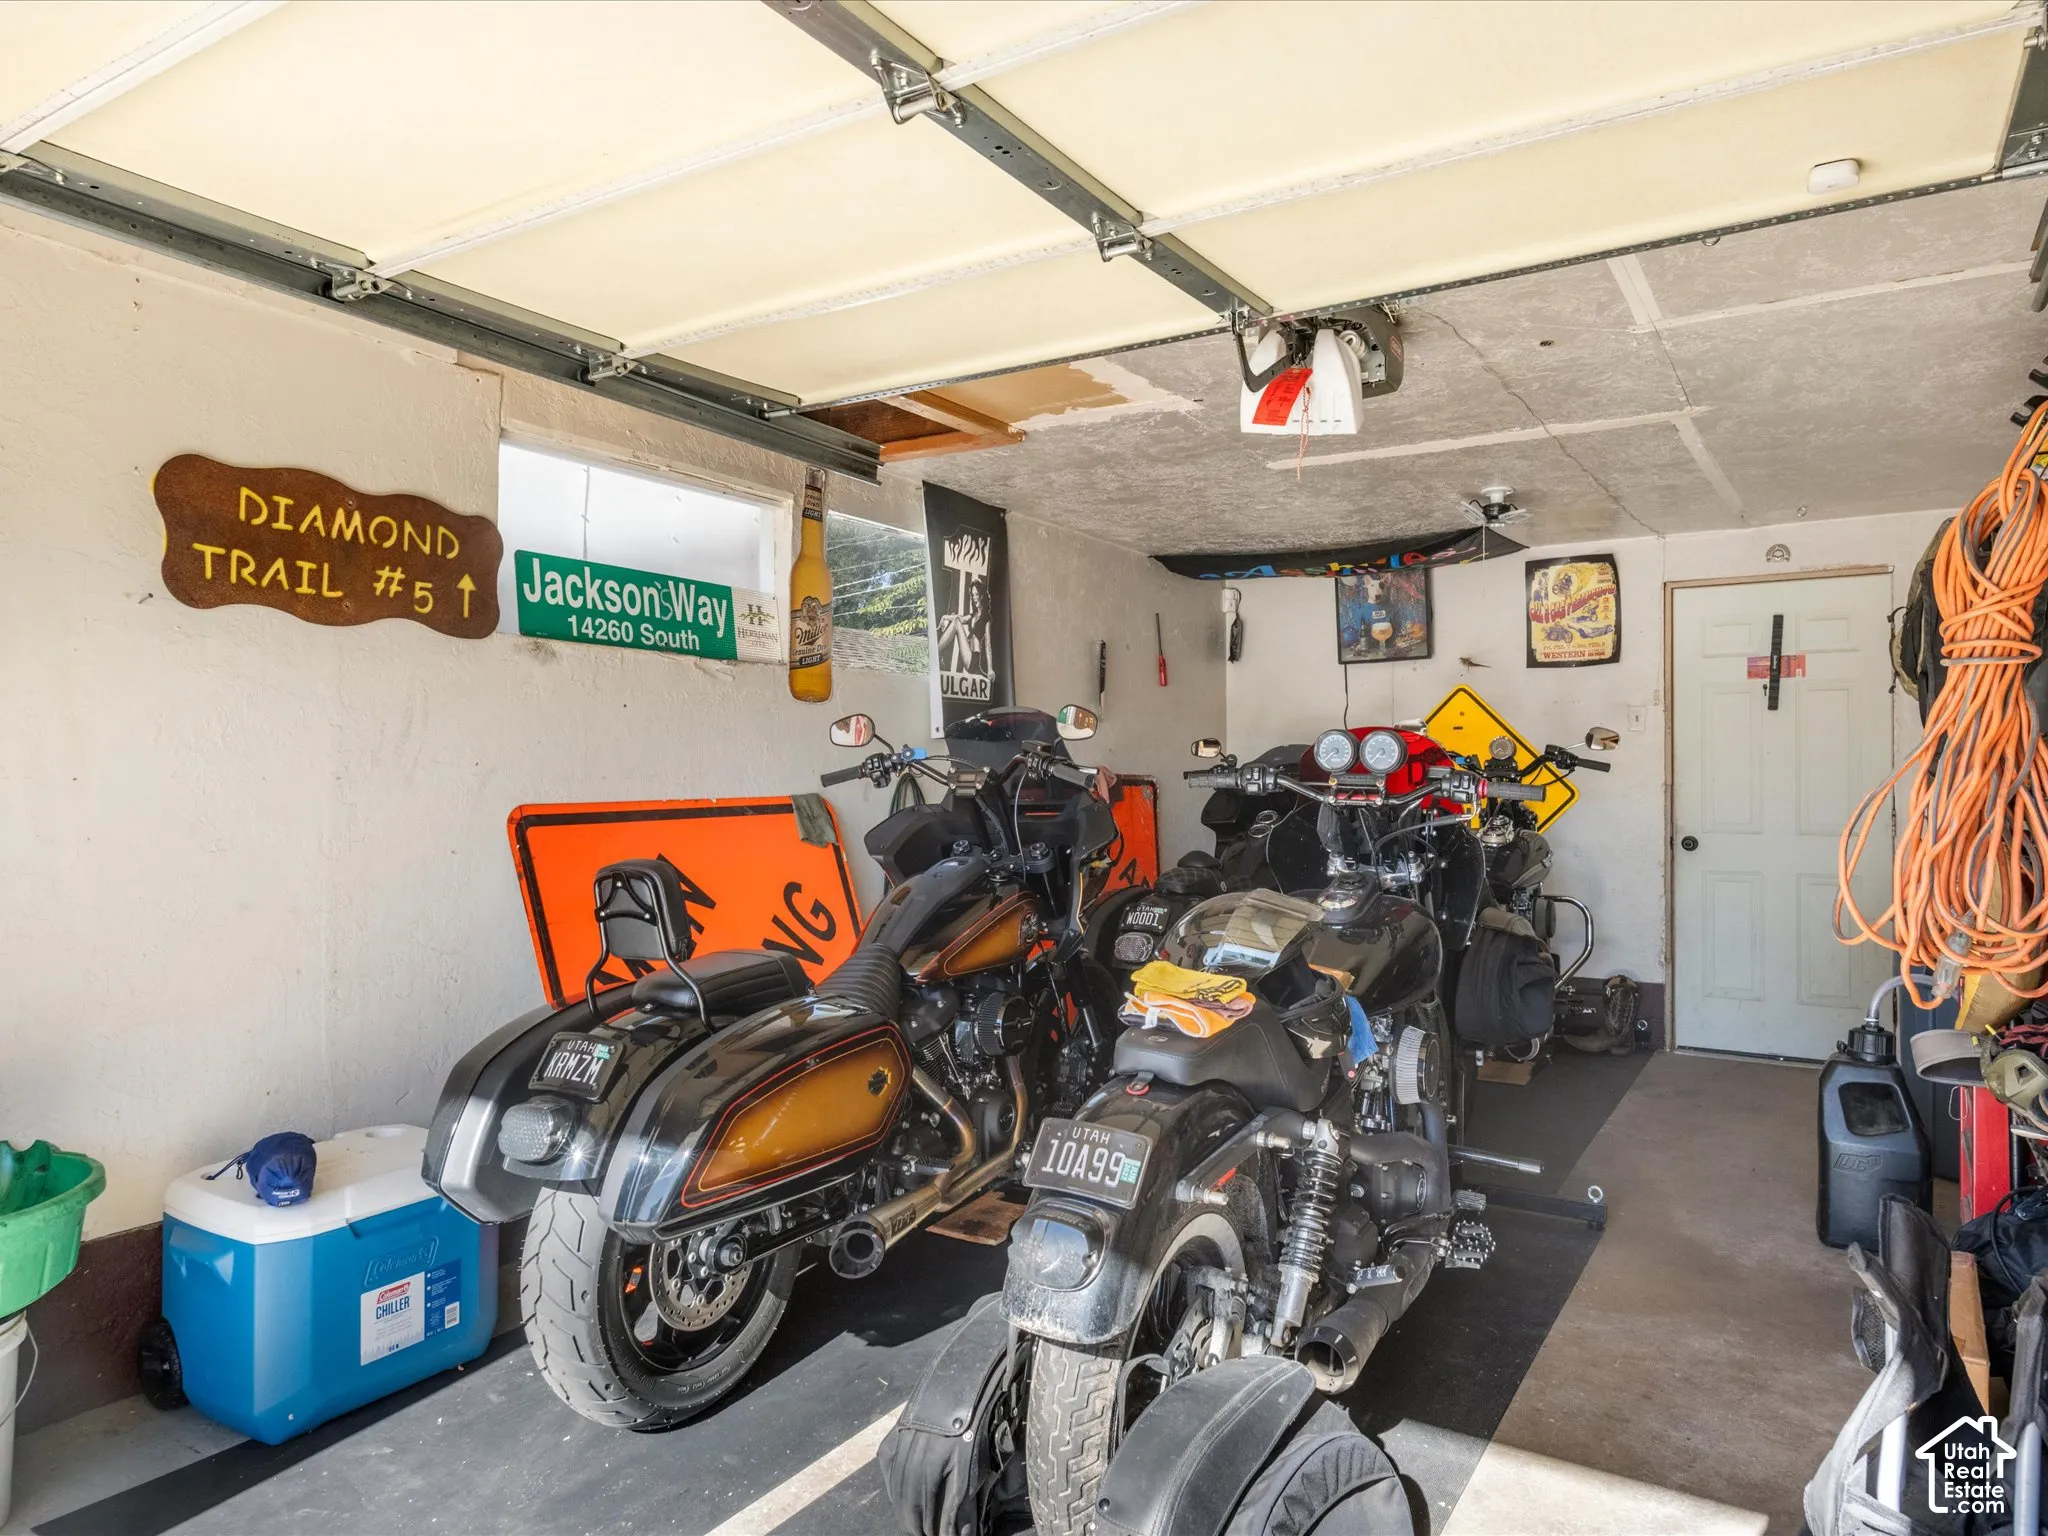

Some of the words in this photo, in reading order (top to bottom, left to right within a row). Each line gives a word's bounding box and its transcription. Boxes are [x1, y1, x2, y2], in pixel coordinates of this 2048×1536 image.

[239, 486, 460, 559] DIAMOND
[192, 543, 344, 598] TRAIL
[668, 580, 727, 638] Way
[567, 615, 634, 643] 14260
[640, 623, 700, 651] South
[795, 623, 828, 645] Miller
[802, 655, 821, 665] LIGHT
[1543, 650, 1586, 659] WESTERN
[567, 1040, 597, 1054] UTAH
[1072, 1127, 1111, 1145] UTAH
[1041, 1139, 1126, 1188] 10A99
[376, 1296, 410, 1320] CHILLER
